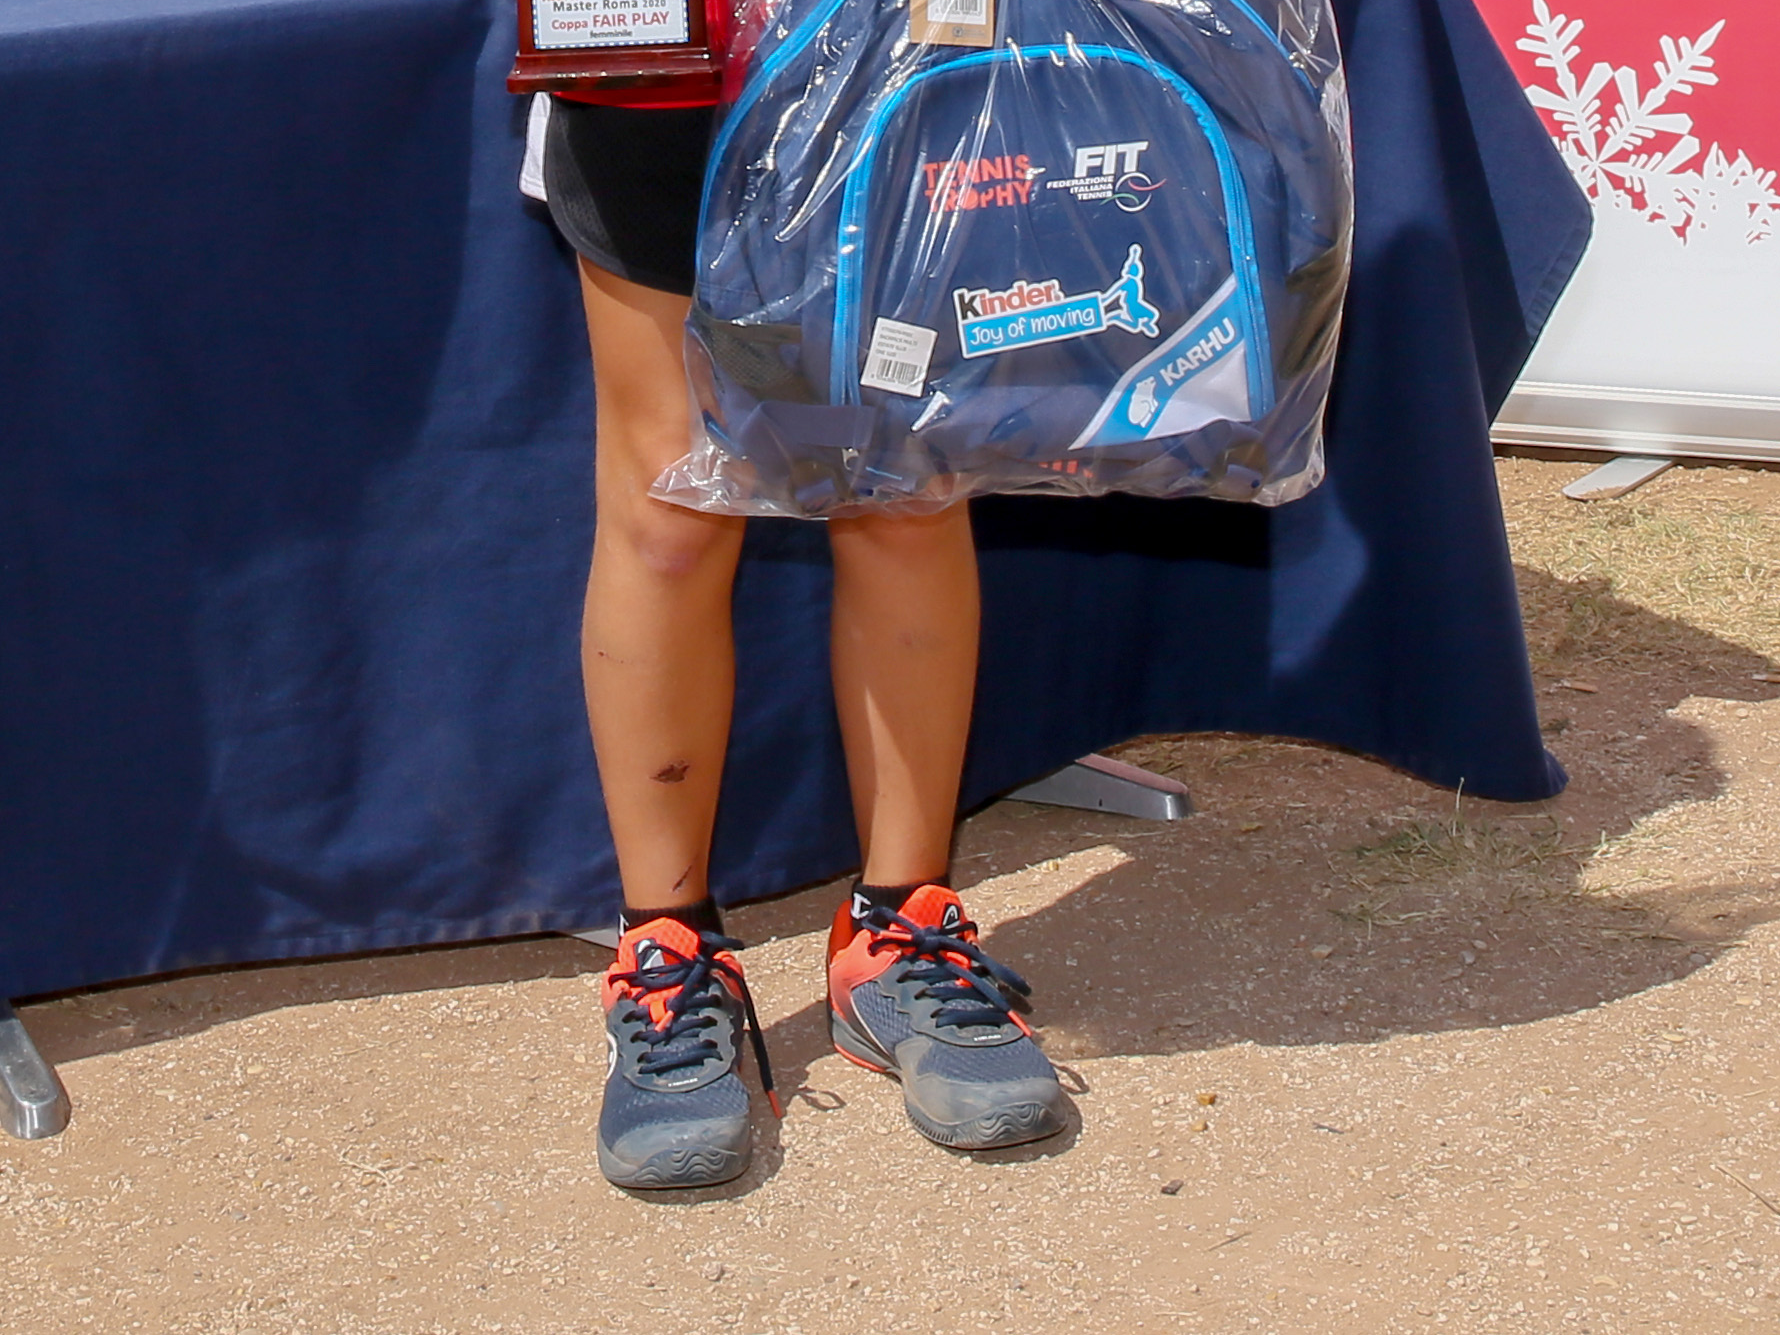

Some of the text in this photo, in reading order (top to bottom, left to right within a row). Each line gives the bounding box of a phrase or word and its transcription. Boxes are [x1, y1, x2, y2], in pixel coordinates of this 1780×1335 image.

[553, 1, 598, 12] Master
[551, 11, 670, 32] Coppa FAIR PLAY
[589, 29, 633, 39] femminile
[1074, 141, 1149, 178] FIT
[923, 154, 1031, 189] TENNIS
[1046, 175, 1115, 190] FEDERAZIONE
[1070, 183, 1114, 194] ITALIANA
[924, 180, 1034, 212] TROPHY
[1077, 190, 1114, 201] TENNIS
[969, 307, 1095, 345] Joy of moving
[1159, 318, 1237, 386] KARHU
